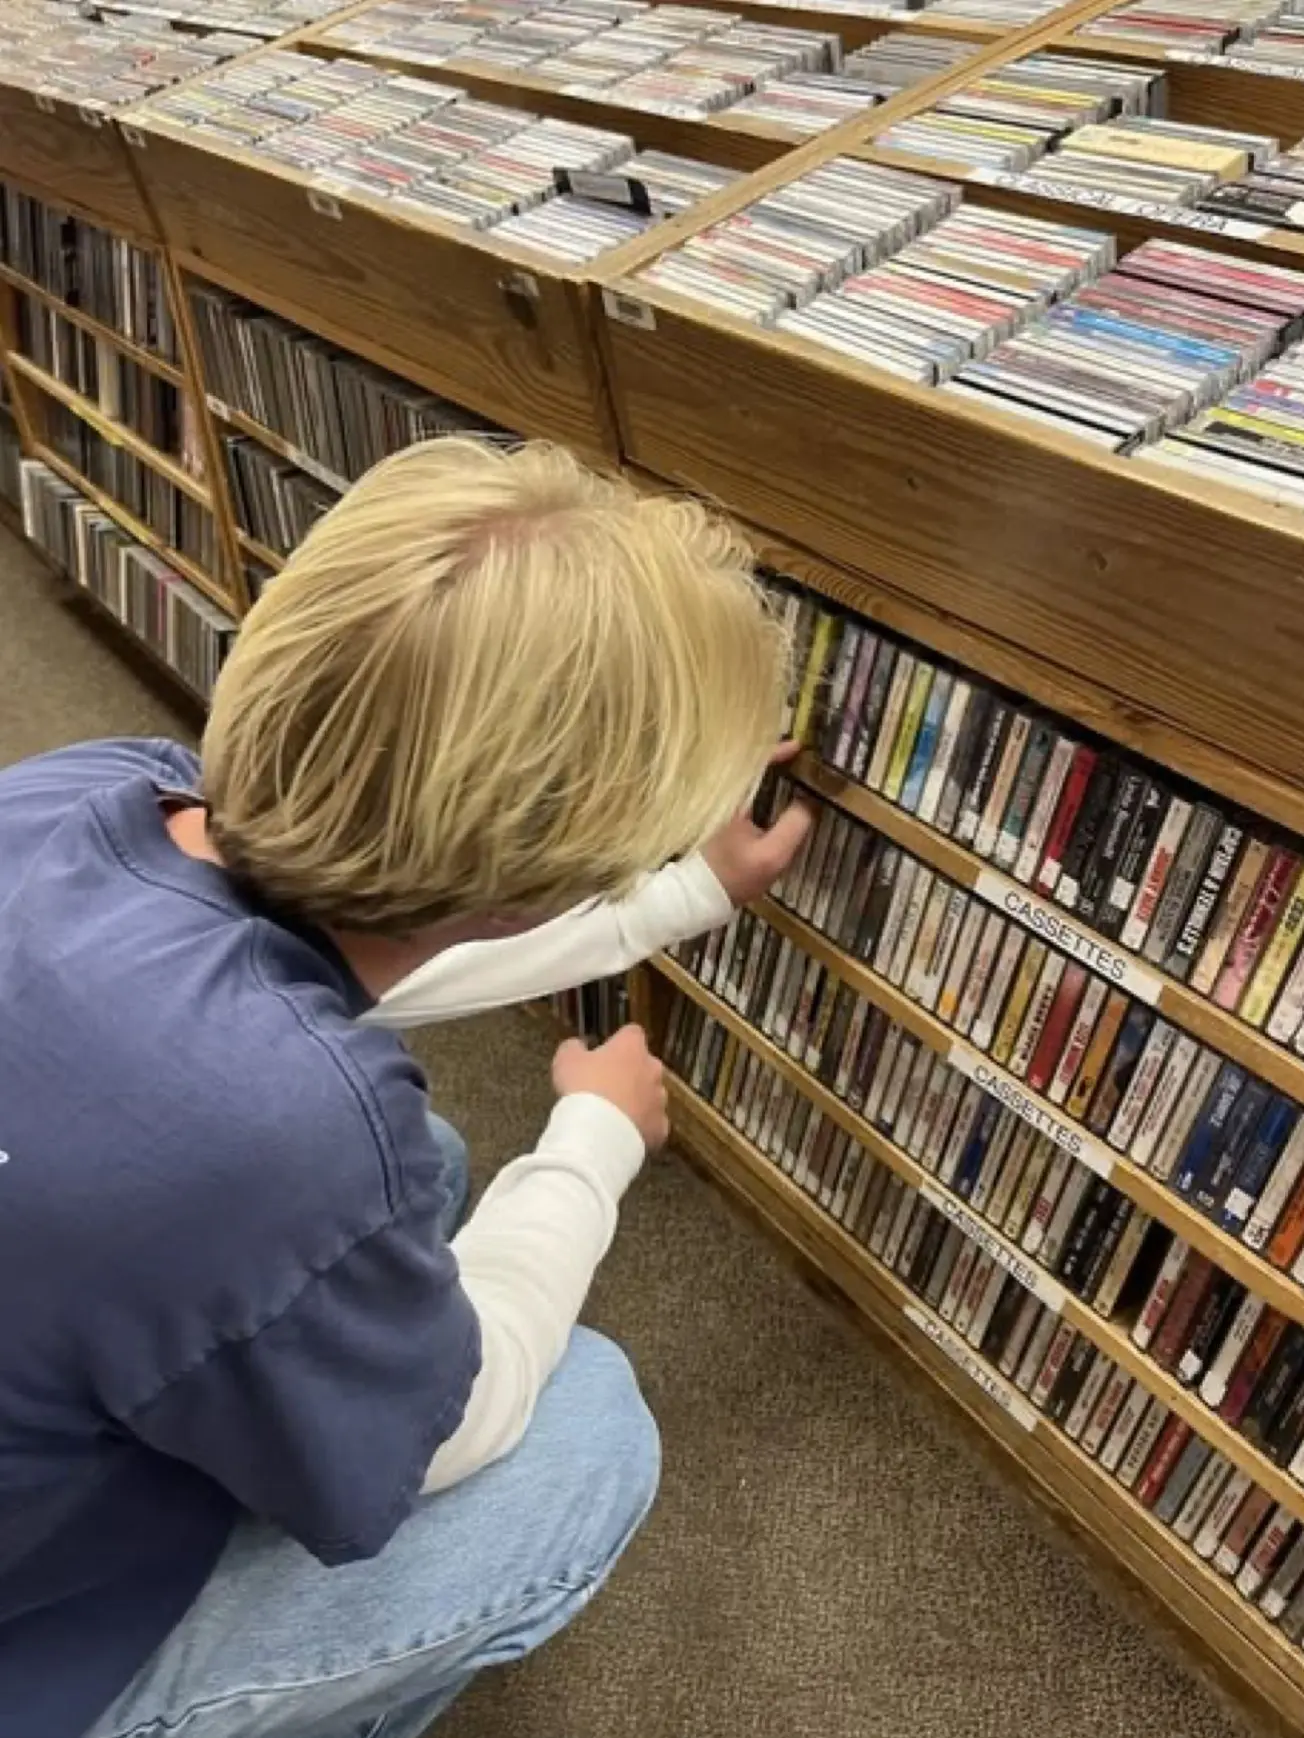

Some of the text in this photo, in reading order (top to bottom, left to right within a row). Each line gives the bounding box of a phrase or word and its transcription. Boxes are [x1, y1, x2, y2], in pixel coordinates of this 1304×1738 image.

[1004, 890, 1128, 981] CASSETTES
[973, 1064, 1083, 1153] CASSETTES
[942, 1199, 1038, 1288] CASSETTES
